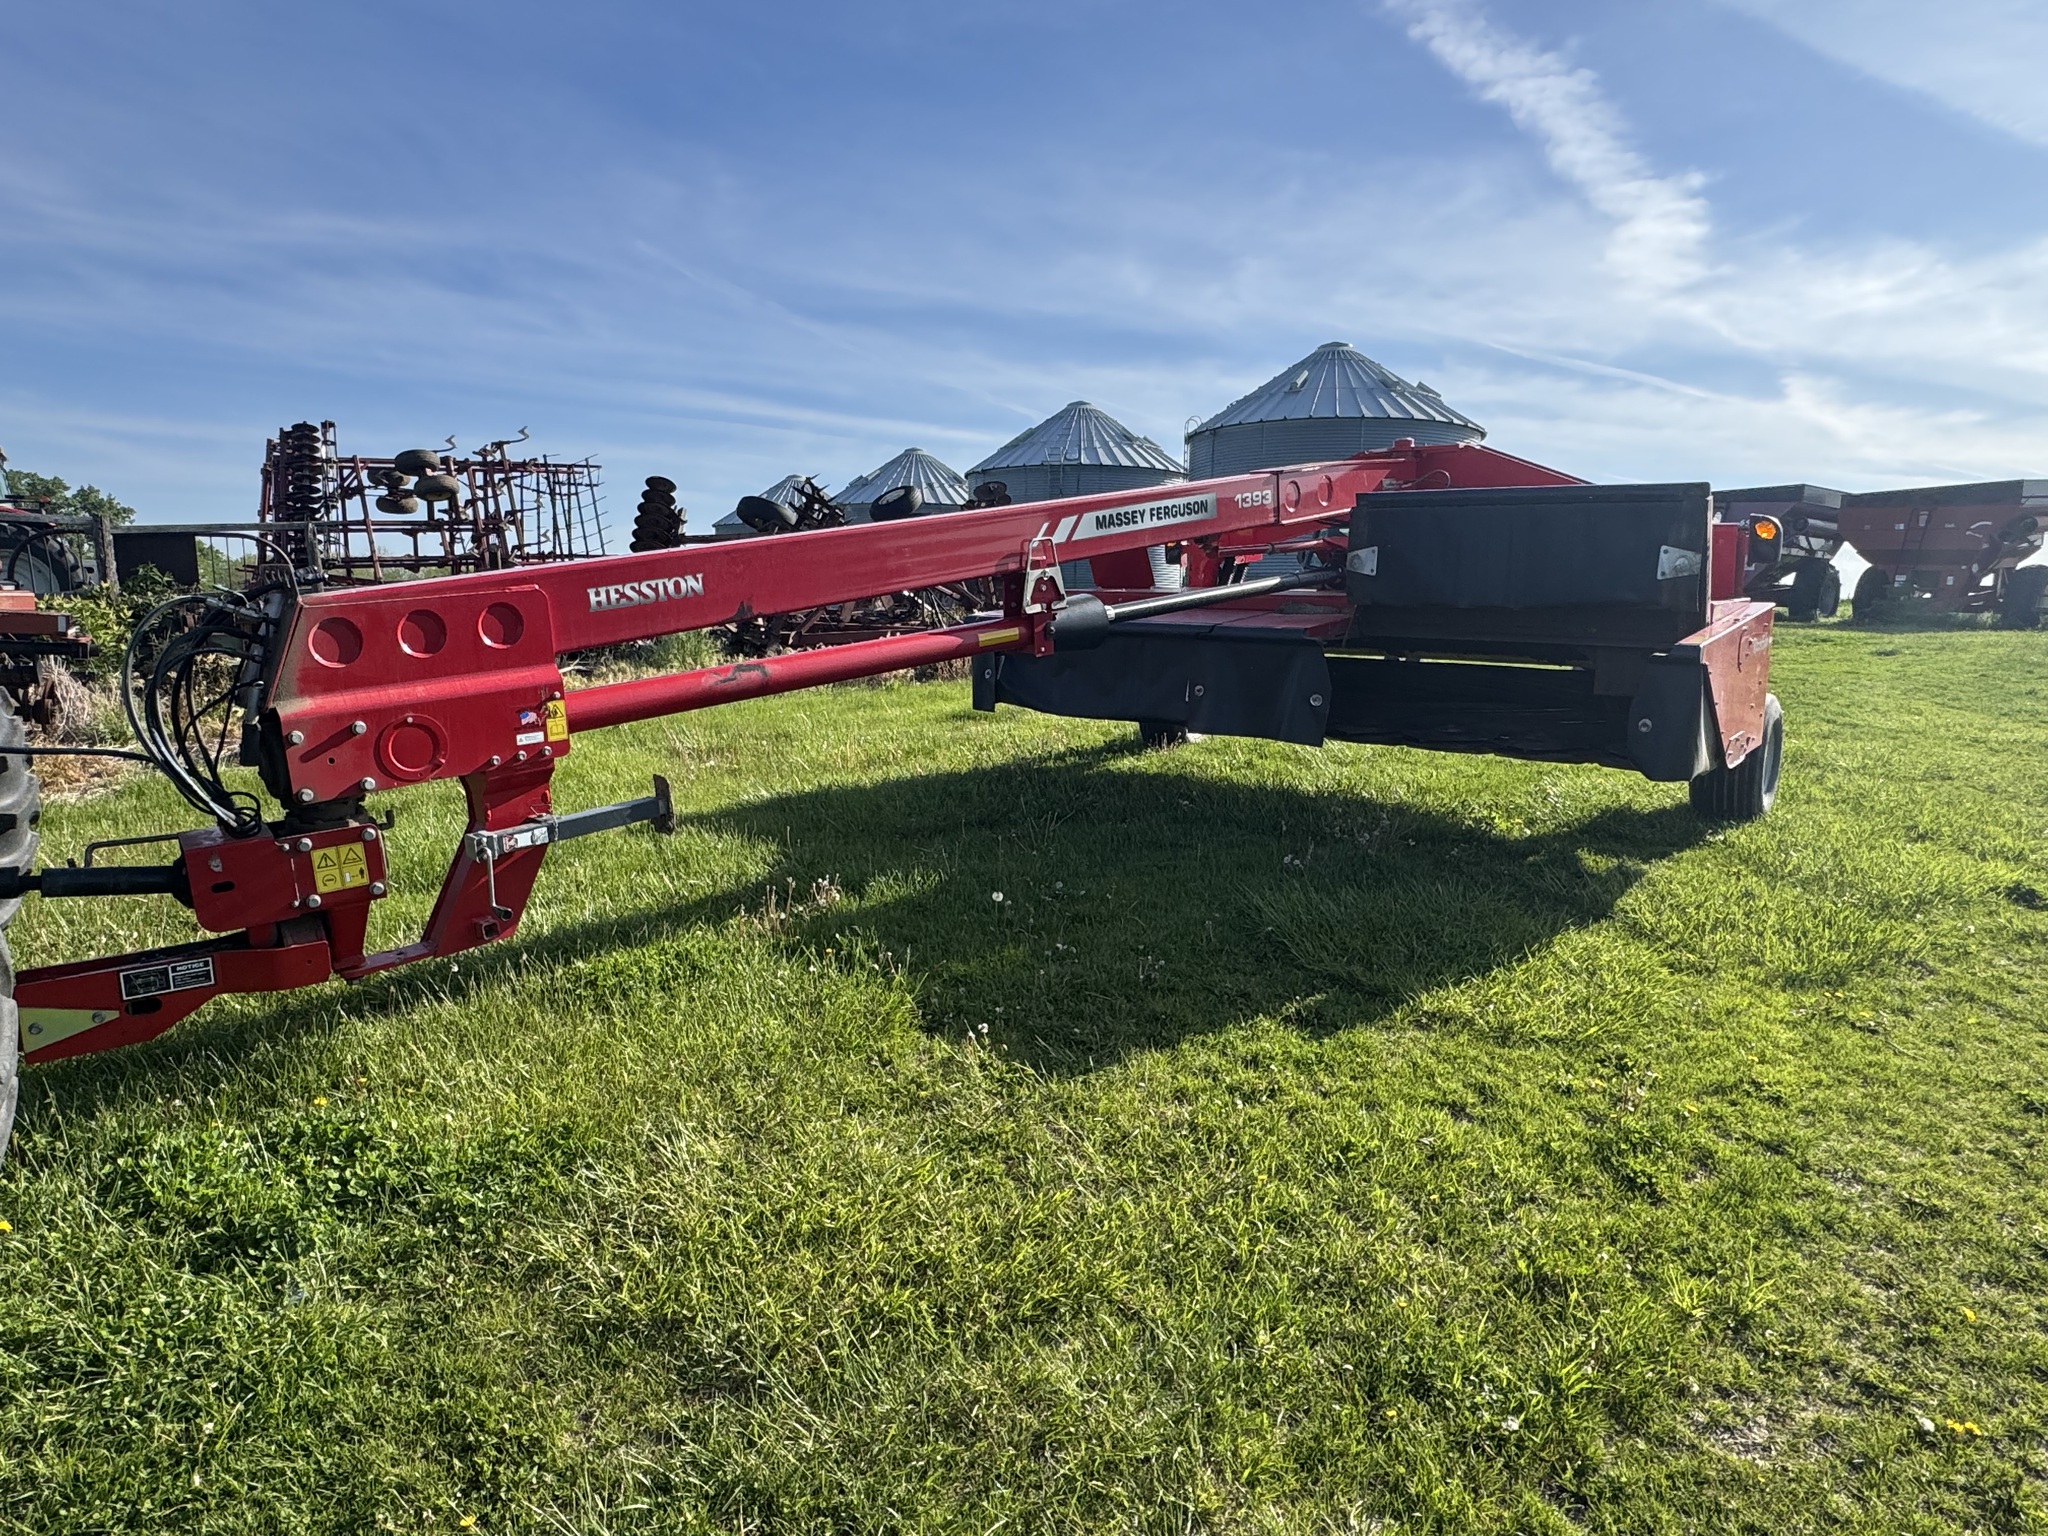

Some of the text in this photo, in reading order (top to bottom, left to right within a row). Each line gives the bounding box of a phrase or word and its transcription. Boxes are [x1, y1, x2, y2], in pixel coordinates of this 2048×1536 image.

[1234, 490, 1272, 509] 1393
[1095, 499, 1208, 531] MASSEY FERGUSON
[587, 573, 704, 612] HESSTON
[176, 962, 205, 971] NOTICE
